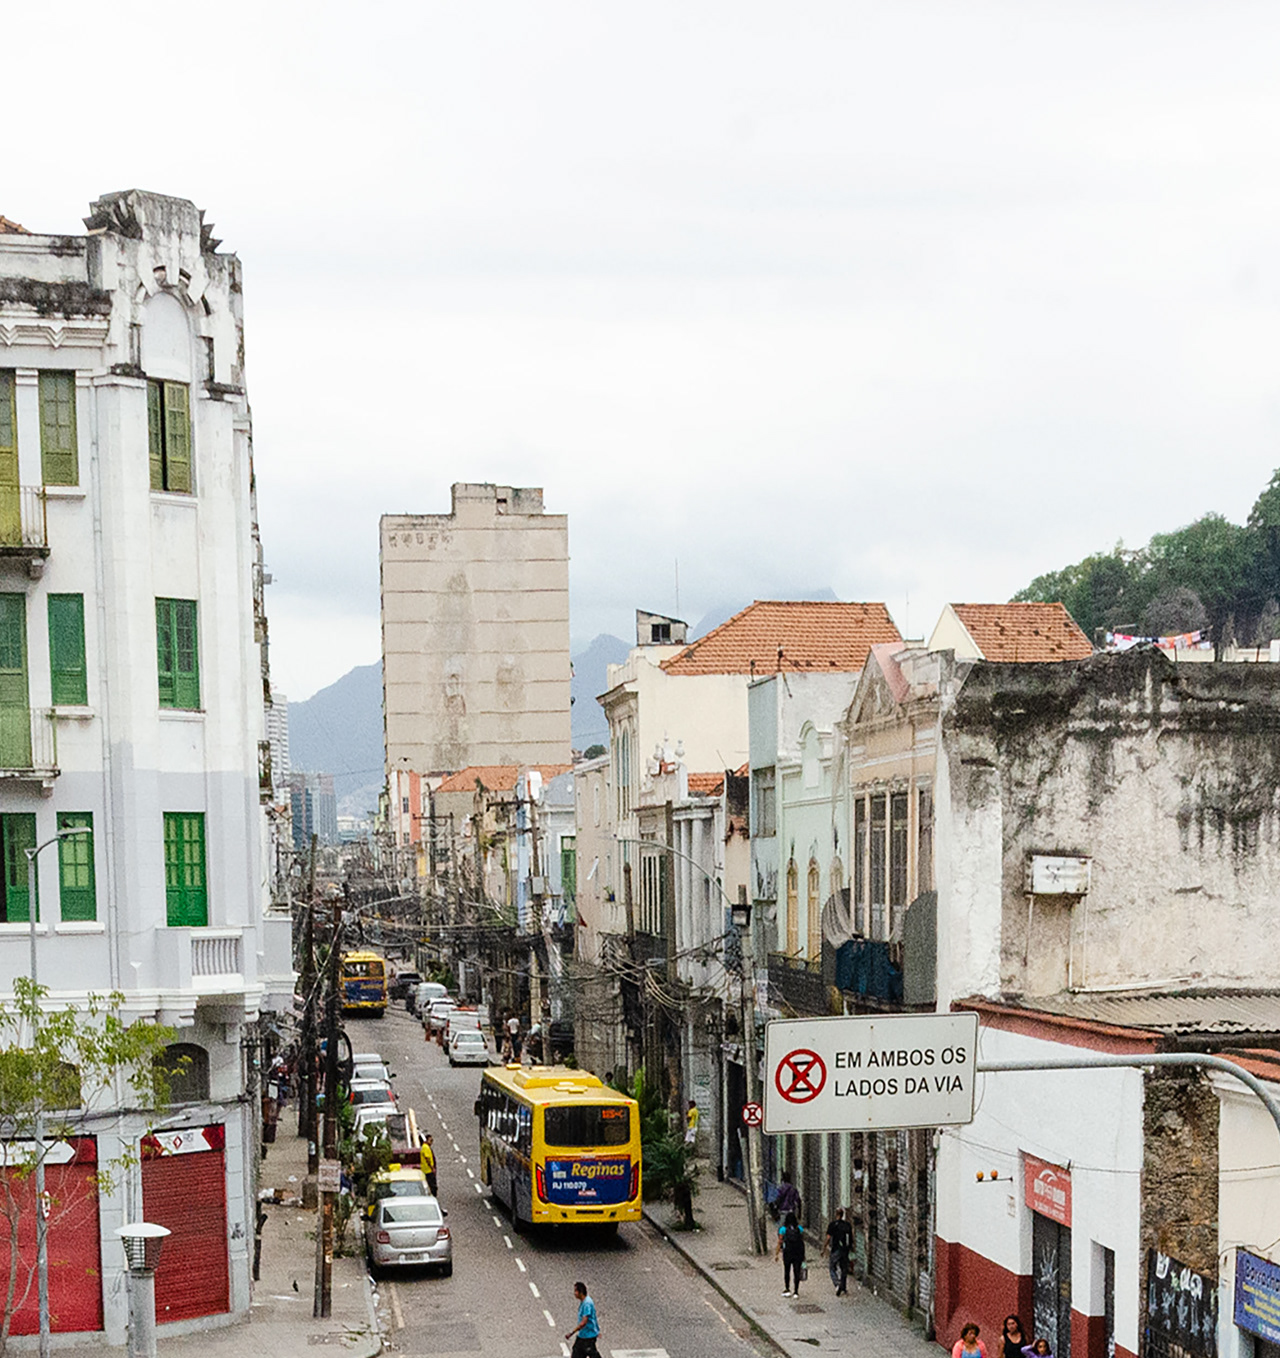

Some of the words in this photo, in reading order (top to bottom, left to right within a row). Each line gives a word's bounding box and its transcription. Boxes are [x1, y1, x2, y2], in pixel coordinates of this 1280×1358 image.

[835, 1051, 861, 1069] EM
[867, 1049, 935, 1068] AMBOS
[941, 1047, 966, 1065] OS
[834, 1078, 898, 1097] LADOS
[904, 1077, 930, 1095] DA
[934, 1075, 964, 1092] VIA
[571, 1161, 625, 1179] Reginas
